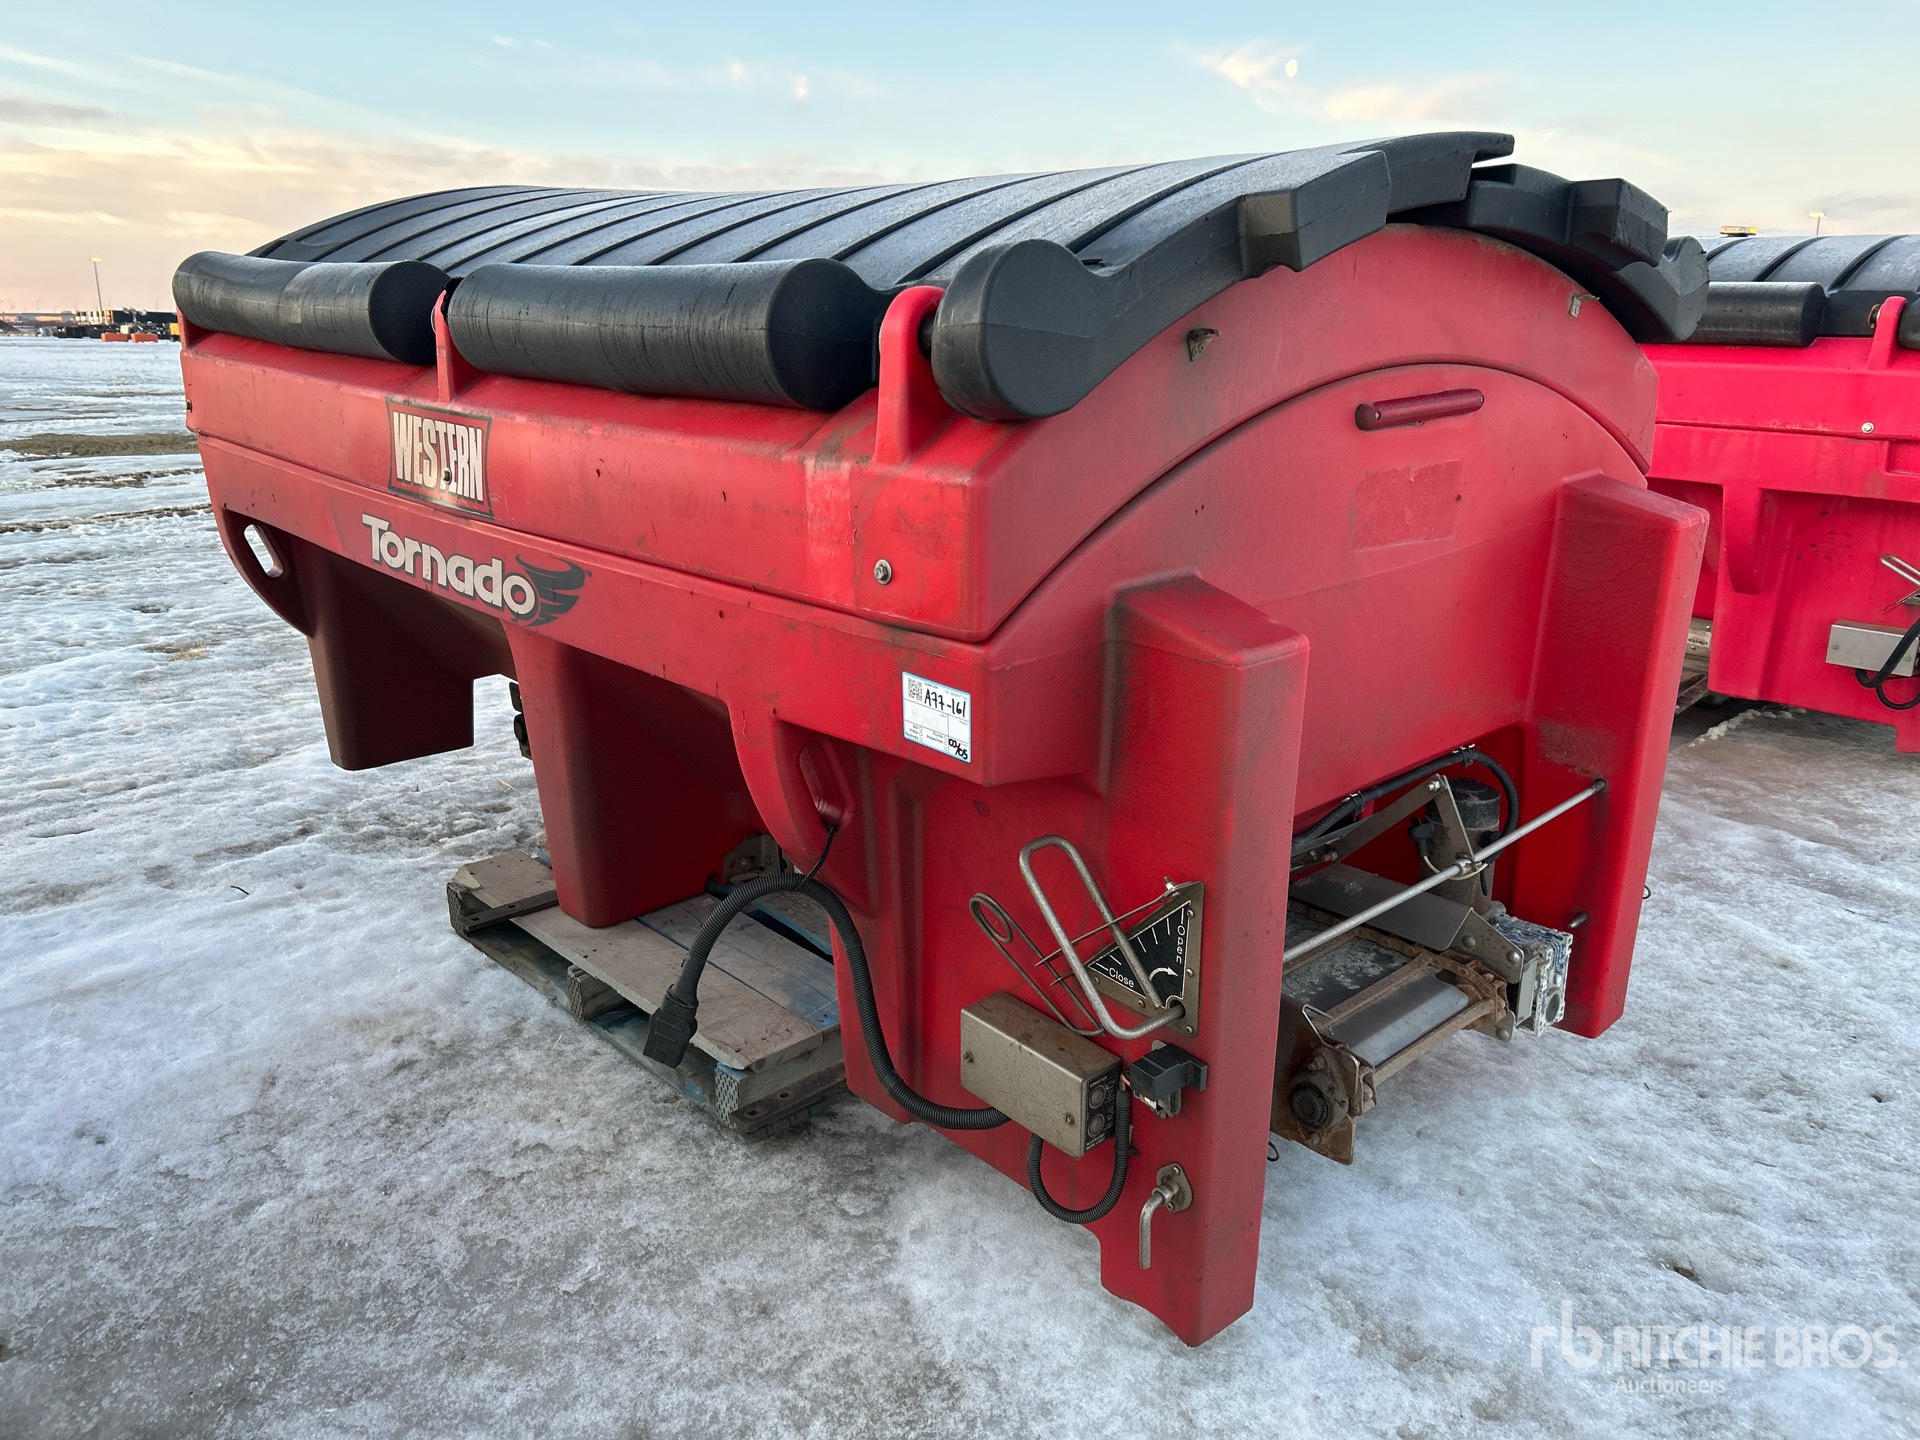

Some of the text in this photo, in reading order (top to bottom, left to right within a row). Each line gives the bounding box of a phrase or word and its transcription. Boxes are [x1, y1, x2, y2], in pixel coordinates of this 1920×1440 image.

[392, 411, 484, 502] WESTERN
[361, 513, 537, 616] Tornado
[924, 688, 967, 718] A77-161
[1175, 925, 1186, 965] Open
[1108, 967, 1135, 988] Close
